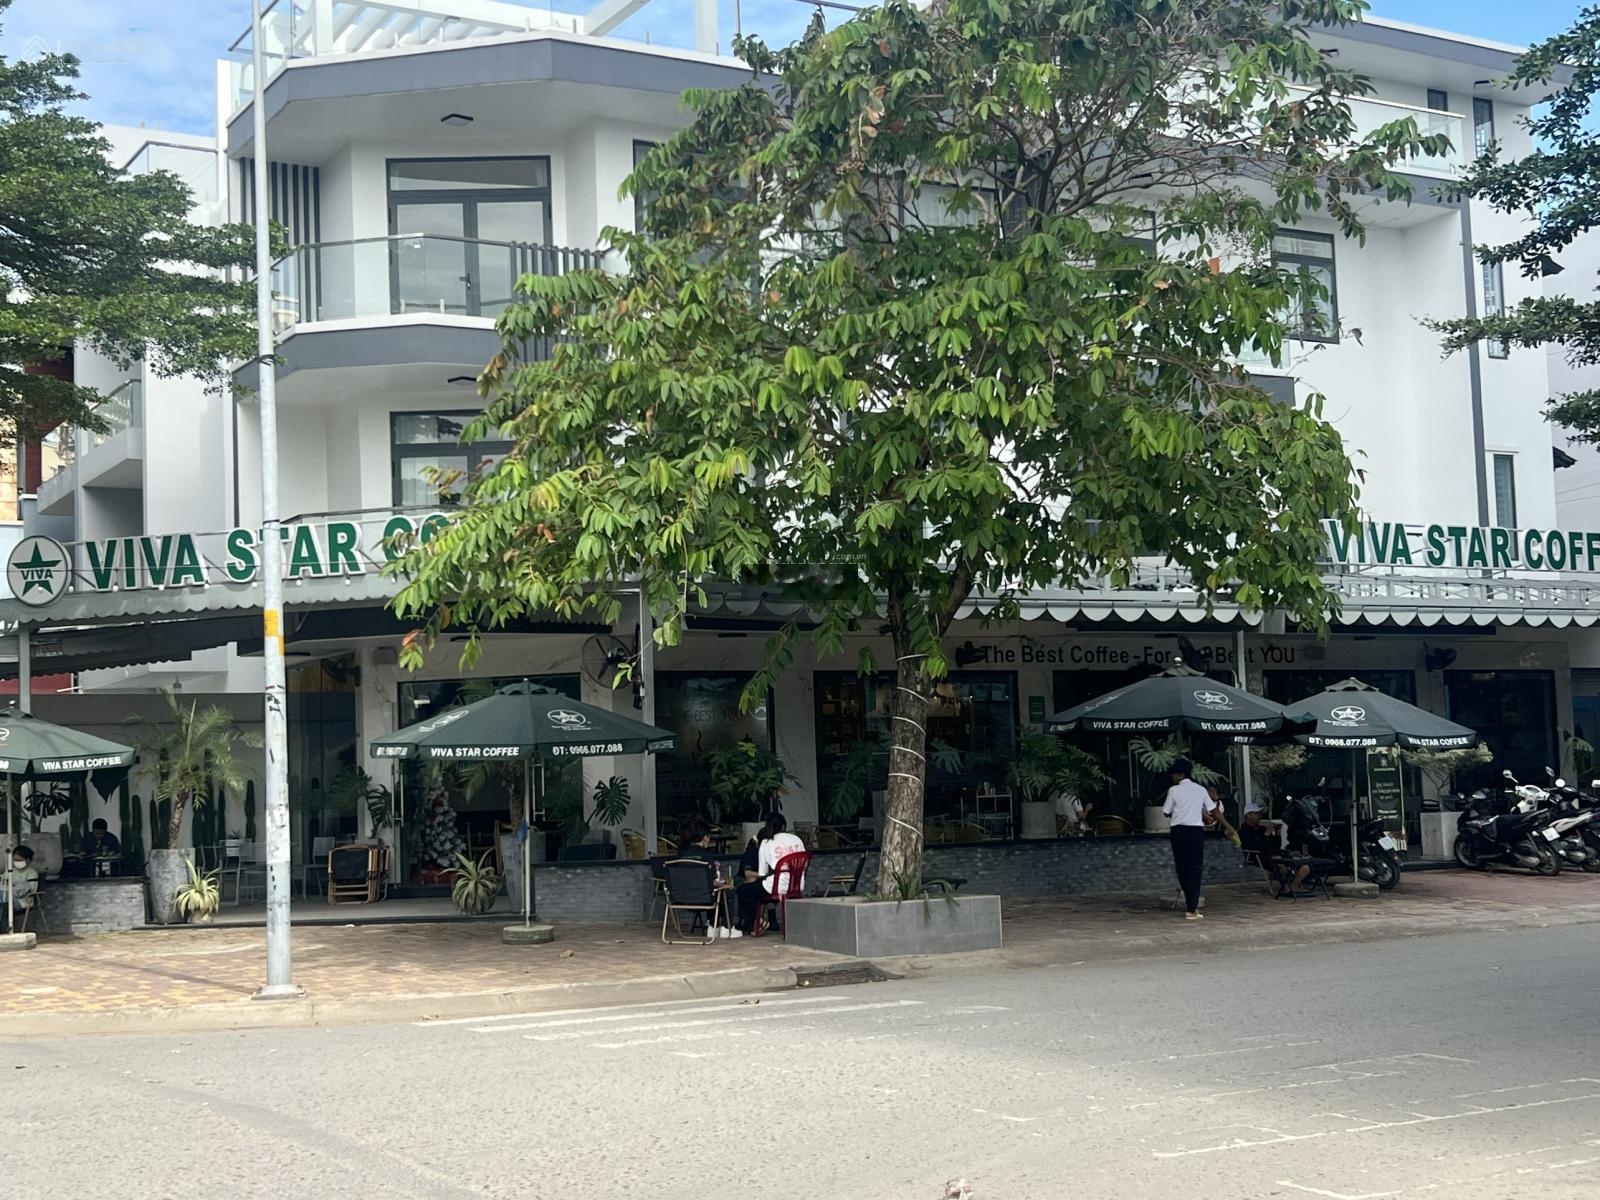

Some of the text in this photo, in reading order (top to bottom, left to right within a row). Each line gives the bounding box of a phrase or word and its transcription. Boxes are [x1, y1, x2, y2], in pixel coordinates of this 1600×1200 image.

[1326, 520, 1413, 565] VIVA
[1427, 524, 1512, 568] STAR
[85, 534, 206, 591] VIVA
[21, 568, 53, 581] VIVA
[980, 645, 1015, 663] The
[1070, 645, 1129, 663] Coffee
[1143, 646, 1171, 663] For
[1259, 647, 1295, 664] YOU
[1093, 719, 1169, 729] VIVA STAR COFFEE
[1422, 738, 1439, 746] STAR
[1439, 737, 1469, 746] COFFEE
[430, 746, 520, 757] VIVA STAR COFFEE
[42, 756, 122, 770] VIVA STAR COFFEE
